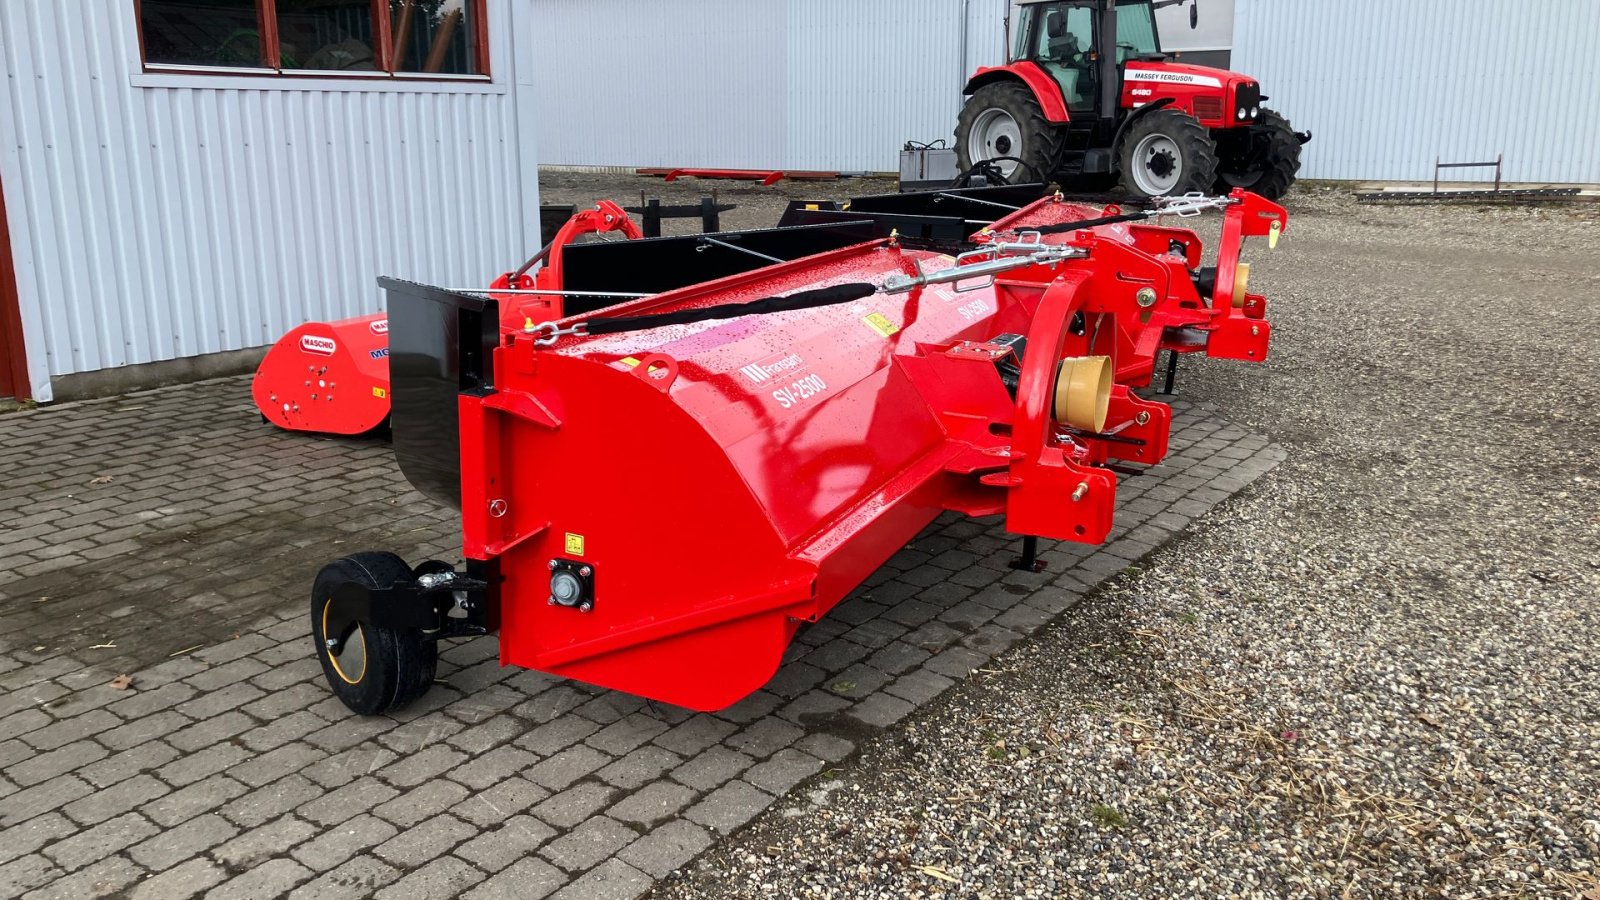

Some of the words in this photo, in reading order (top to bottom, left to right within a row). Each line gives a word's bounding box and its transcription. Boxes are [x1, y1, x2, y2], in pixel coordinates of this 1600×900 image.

[1160, 74, 1193, 82] FERGUSON
[304, 338, 333, 349] MASCHIO
[772, 373, 827, 409] SV-2500
